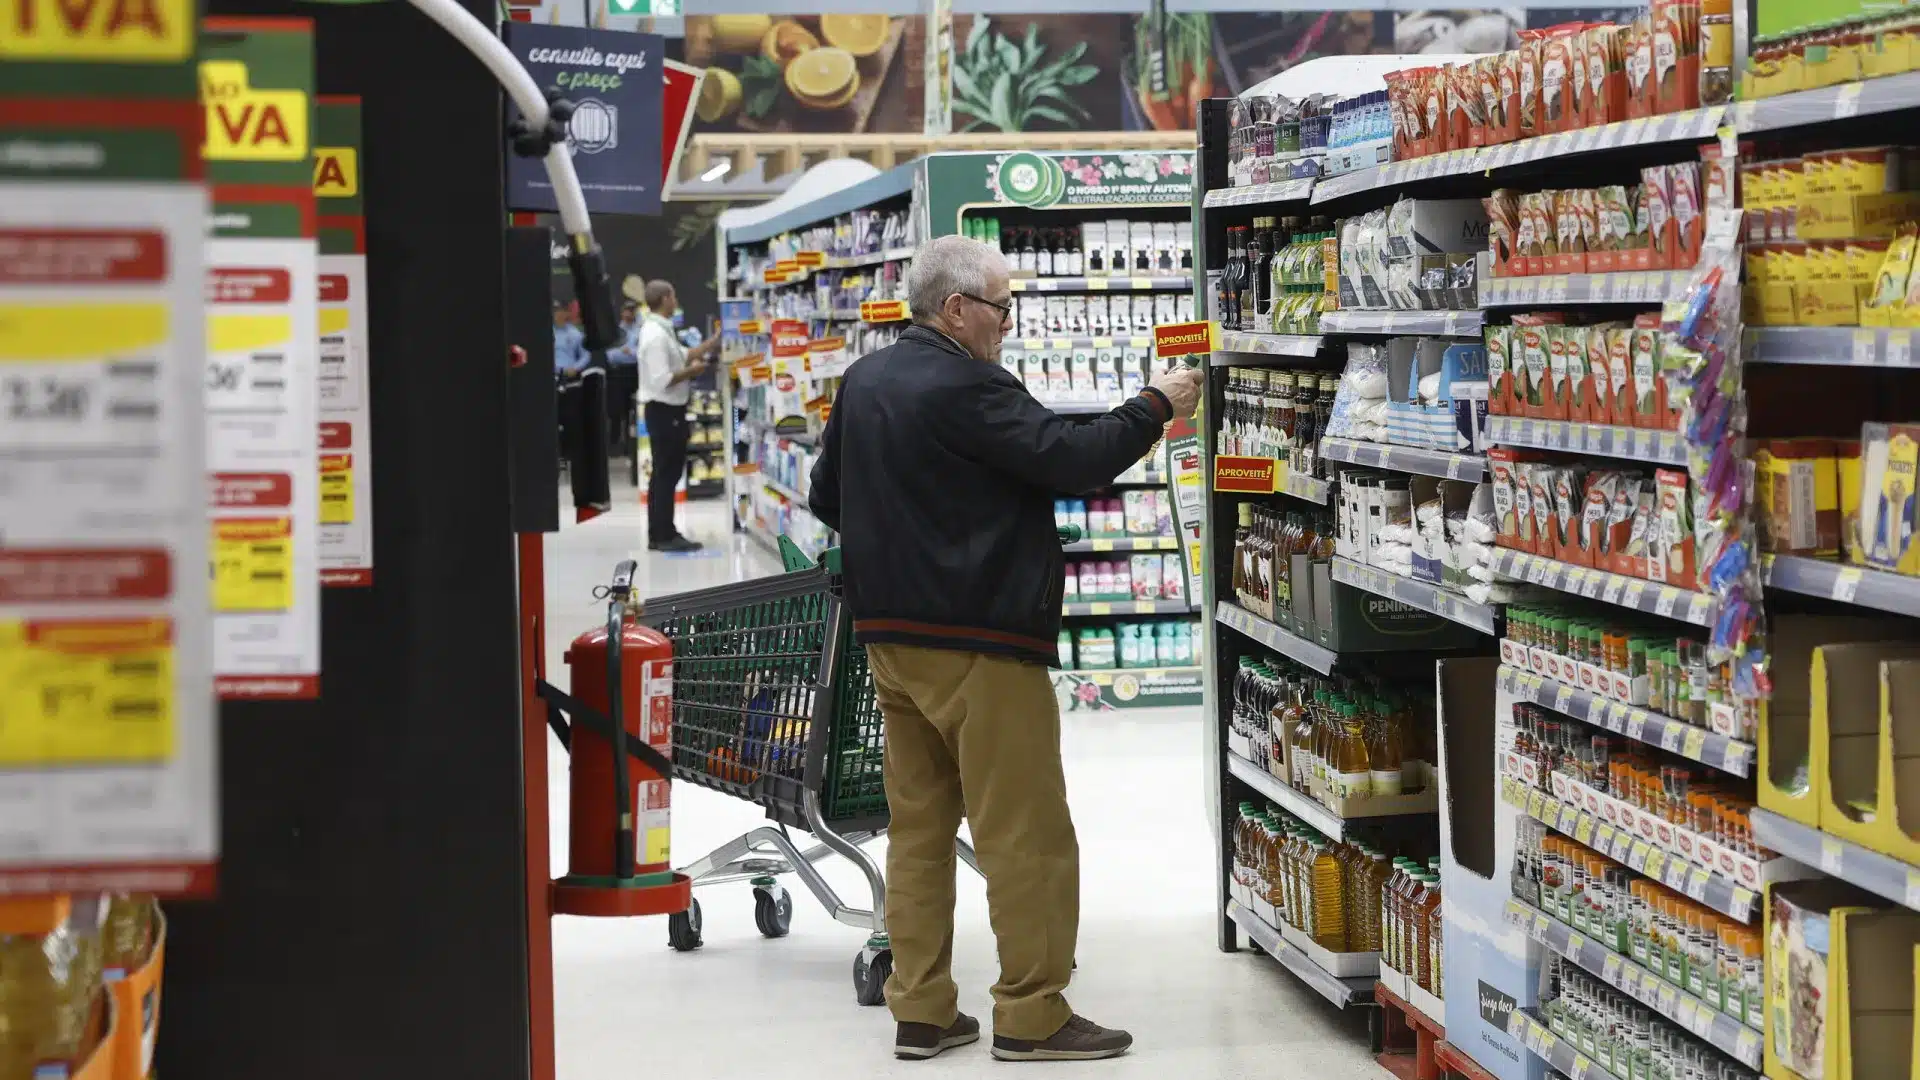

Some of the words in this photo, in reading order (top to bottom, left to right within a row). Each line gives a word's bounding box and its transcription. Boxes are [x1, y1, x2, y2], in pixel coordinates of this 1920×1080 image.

[528, 46, 604, 67] consulte
[604, 50, 647, 75] aqui
[569, 71, 623, 93] preço
[1076, 185, 1111, 196] NOSSO
[1120, 184, 1153, 195] SPRAY
[1157, 328, 1208, 346] APROVEITE!
[1460, 351, 1489, 376] SAL
[1218, 465, 1272, 478] APROVEITE!
[1480, 991, 1498, 1019] pingo
[1498, 995, 1514, 1014] doce
